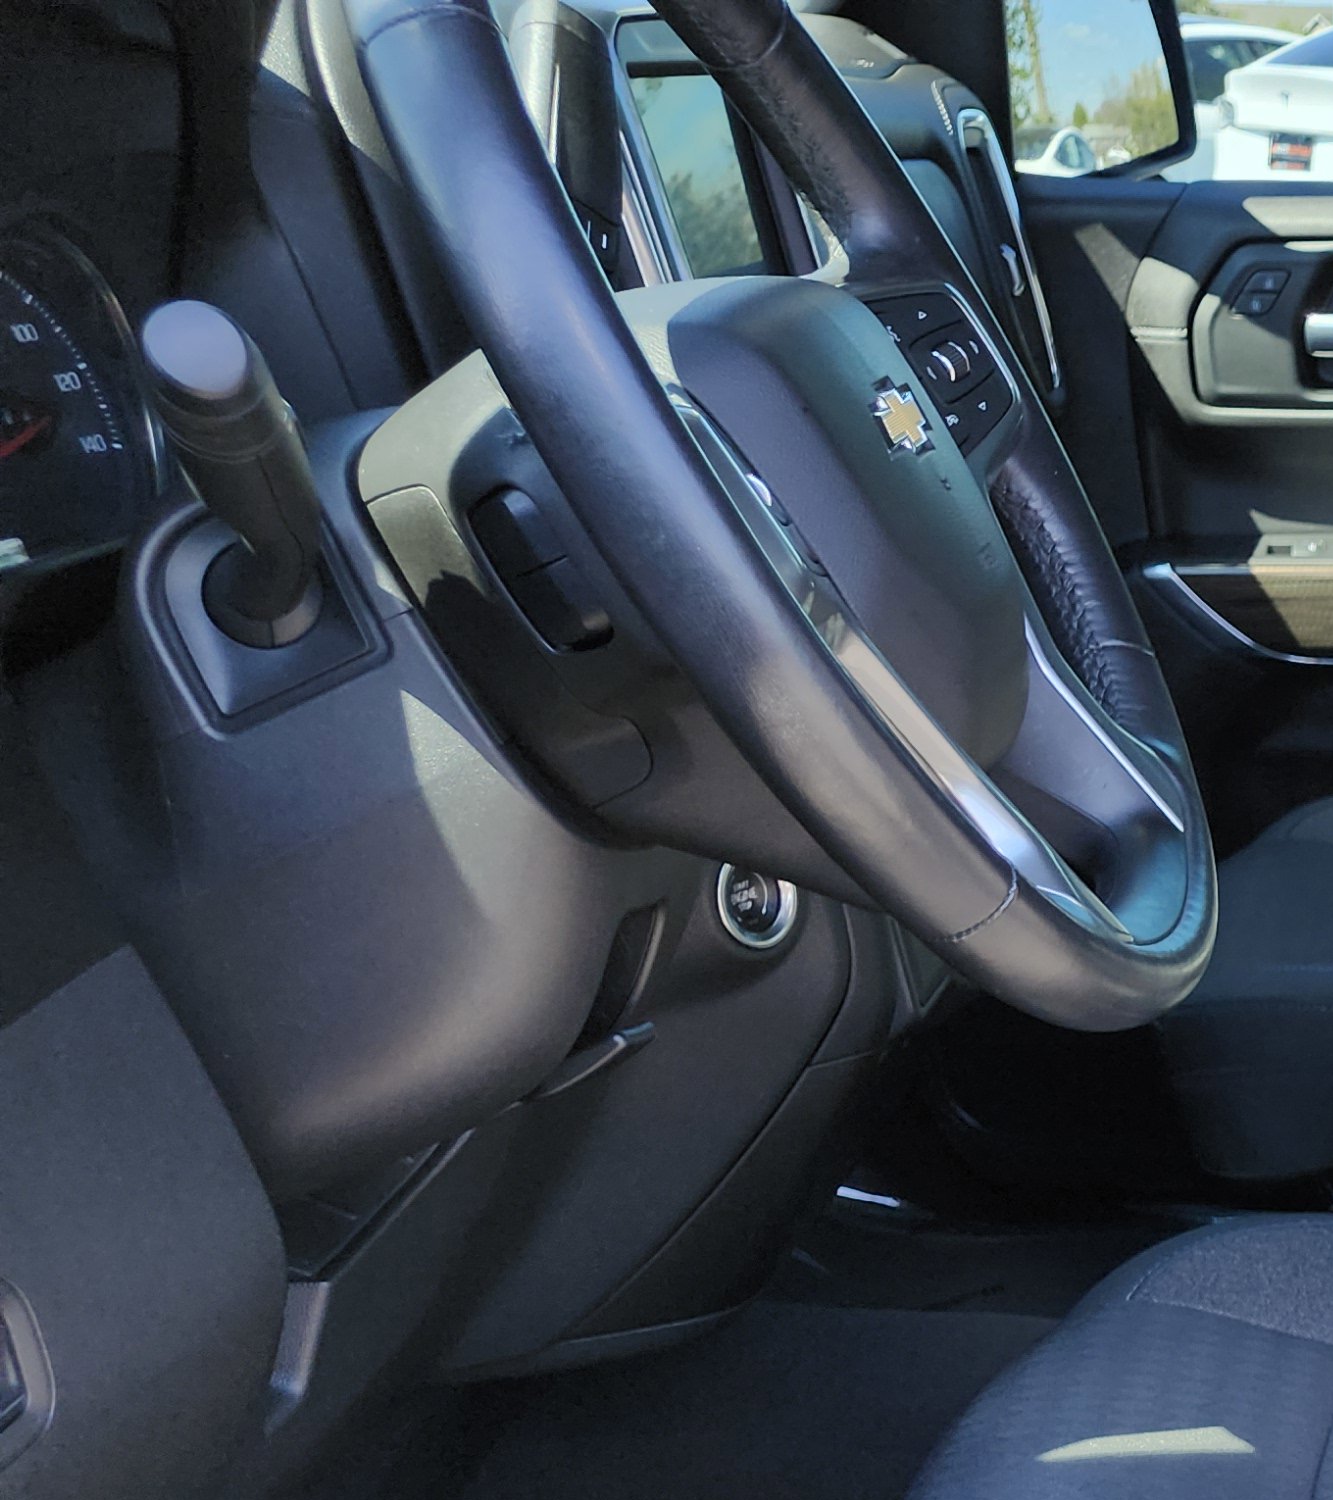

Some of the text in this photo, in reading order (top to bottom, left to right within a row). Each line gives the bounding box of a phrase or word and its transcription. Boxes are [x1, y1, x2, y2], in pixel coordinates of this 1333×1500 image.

[10, 322, 39, 343] 100
[53, 371, 82, 392] 120
[79, 433, 107, 454] 140
